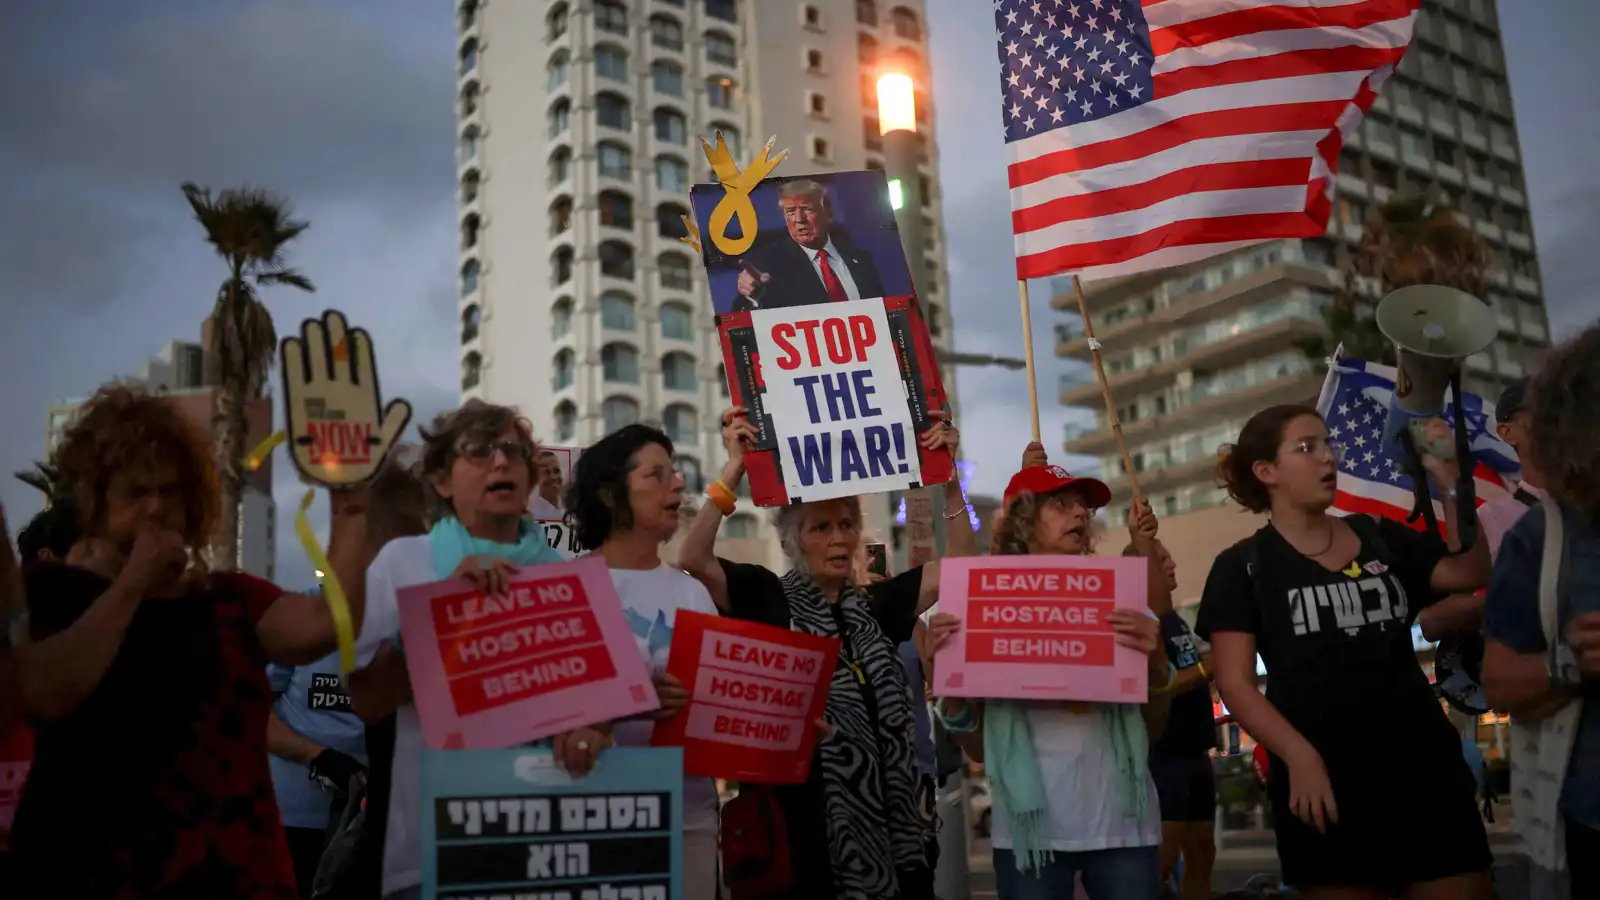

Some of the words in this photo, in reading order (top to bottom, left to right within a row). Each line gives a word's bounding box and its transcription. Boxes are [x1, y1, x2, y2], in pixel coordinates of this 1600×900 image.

[771, 315, 877, 370] STOP
[793, 369, 882, 424] THE
[307, 422, 371, 455] NOW
[787, 422, 909, 486] WAR!
[981, 574, 1059, 591] LEAVE
[1066, 575, 1102, 592] NO
[446, 588, 535, 624] LEAVE
[537, 583, 573, 603] NO
[982, 606, 1098, 624] HOSTAGE
[457, 618, 587, 663] HOSTAGE
[715, 640, 789, 671] LEAVE
[792, 656, 815, 676] NO
[993, 638, 1086, 657] BEHIND
[482, 656, 587, 699] BEHIND
[710, 676, 806, 708] HOSTAGE
[714, 715, 790, 742] BEHIND
[446, 797, 550, 836] מדיני
[560, 795, 661, 832] הסכם
[526, 842, 590, 879] הוא
